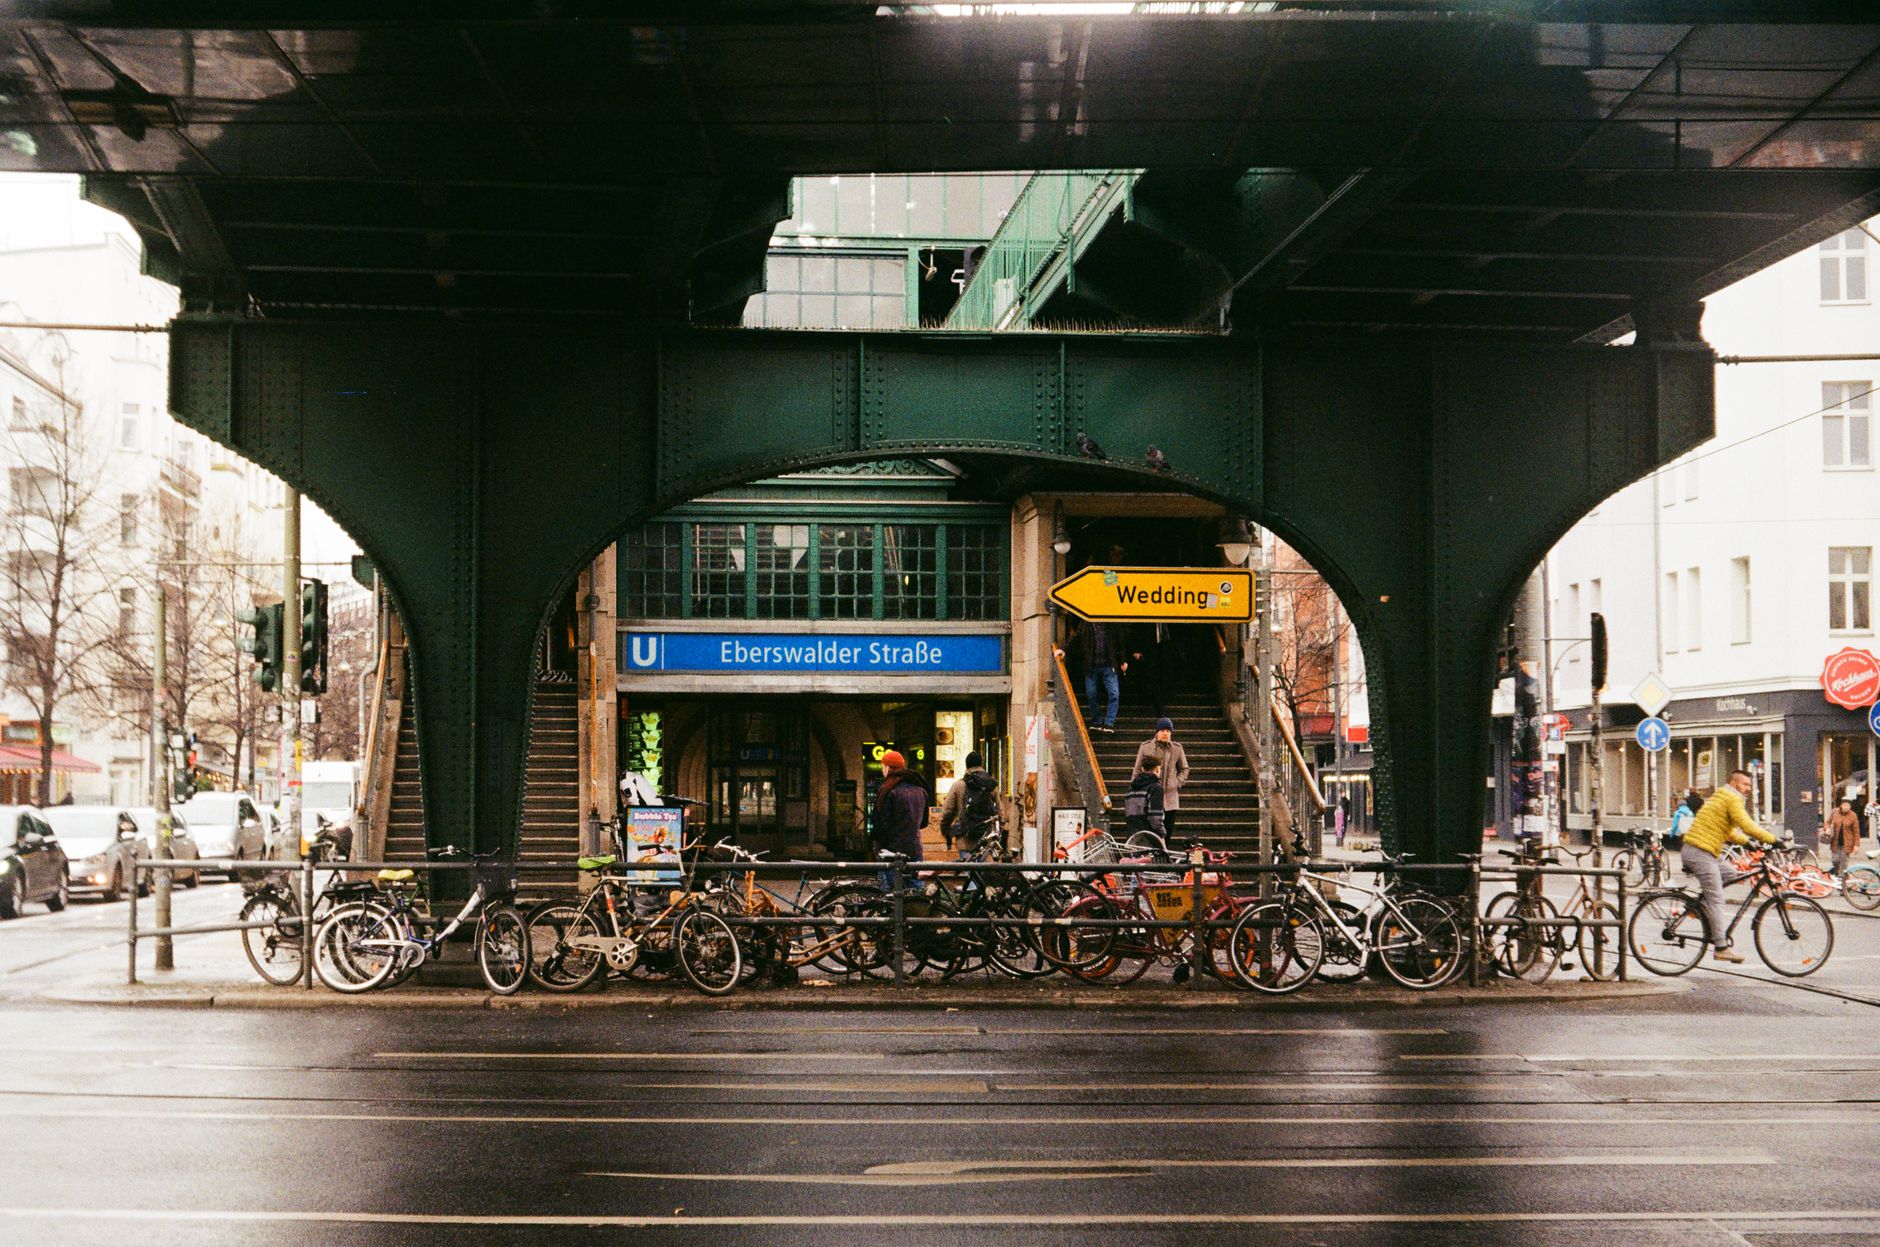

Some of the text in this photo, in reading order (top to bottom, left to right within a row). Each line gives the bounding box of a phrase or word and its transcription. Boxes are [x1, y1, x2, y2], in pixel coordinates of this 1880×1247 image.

[1117, 585, 1208, 609] Wedding
[632, 636, 942, 667] U Eberswalder Straße
[633, 811, 662, 821] Bubble
